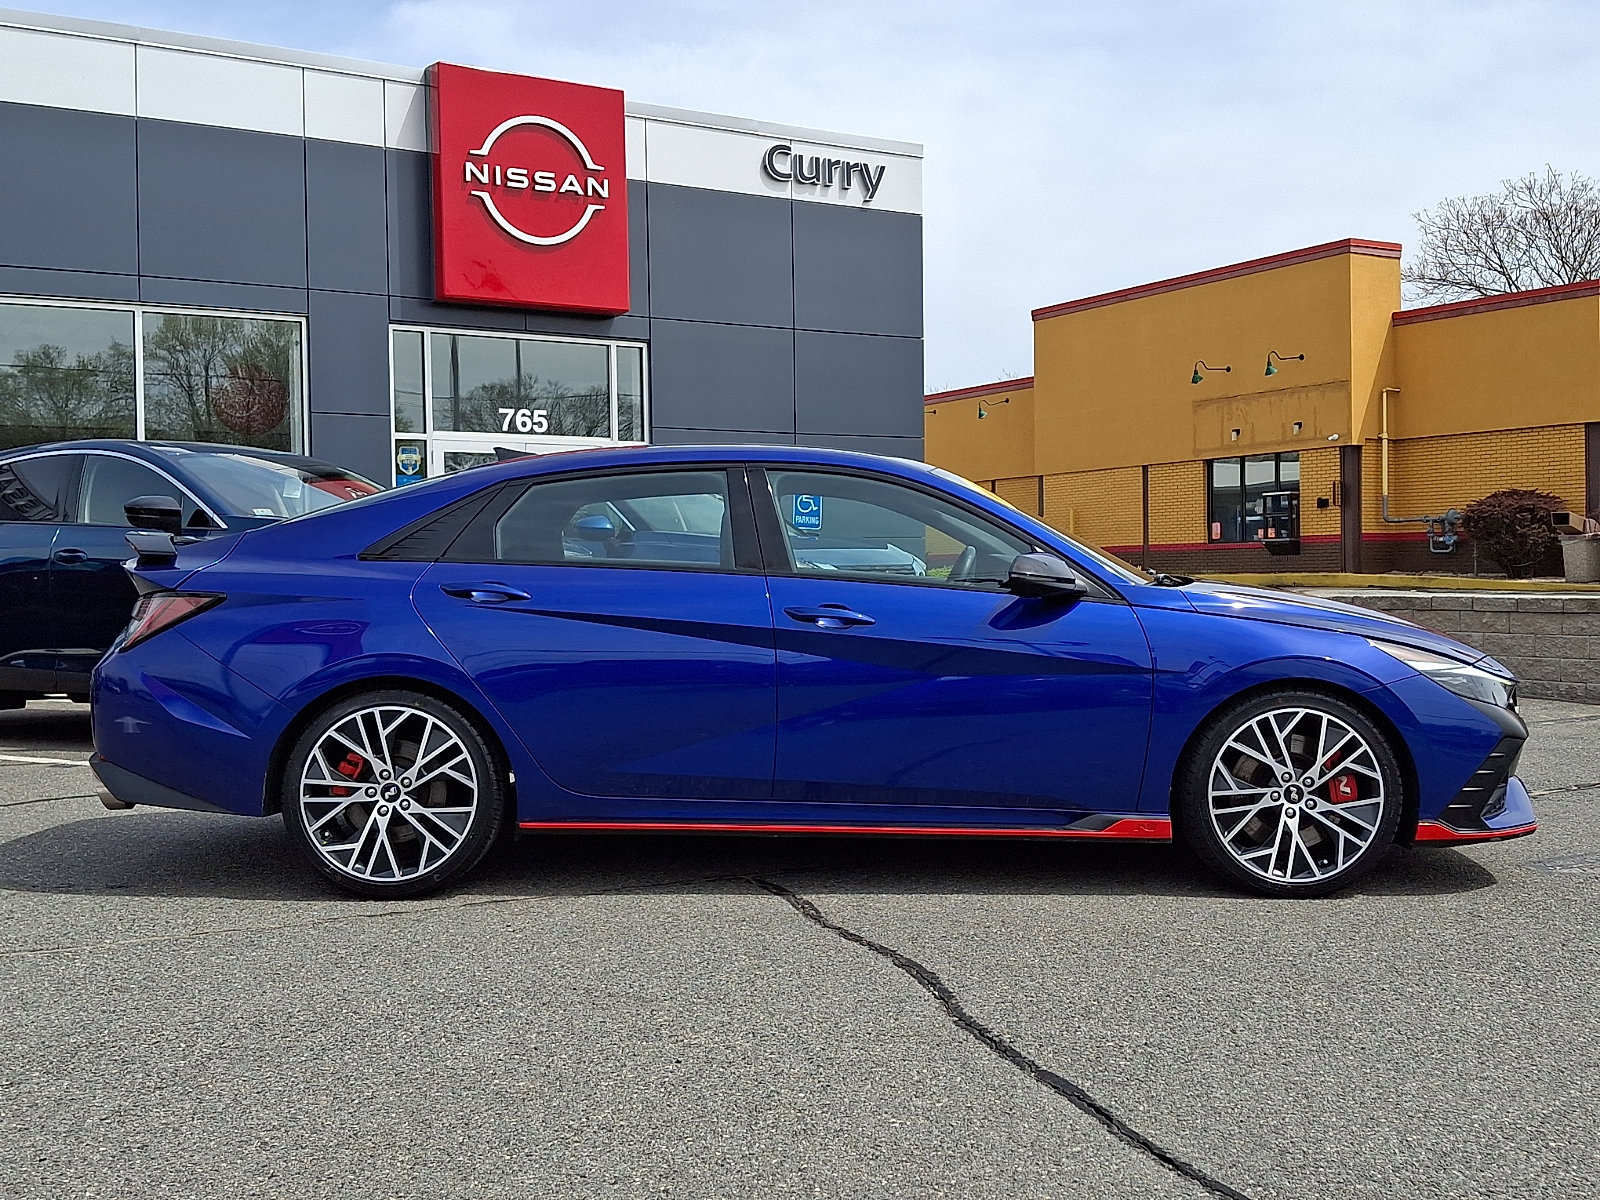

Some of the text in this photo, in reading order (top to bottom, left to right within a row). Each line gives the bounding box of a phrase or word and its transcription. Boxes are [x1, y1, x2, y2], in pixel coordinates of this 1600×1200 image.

[464, 161, 610, 199] NISSAN
[762, 144, 886, 203] Curry
[498, 407, 549, 433] 765
[795, 515, 820, 525] PARKING
